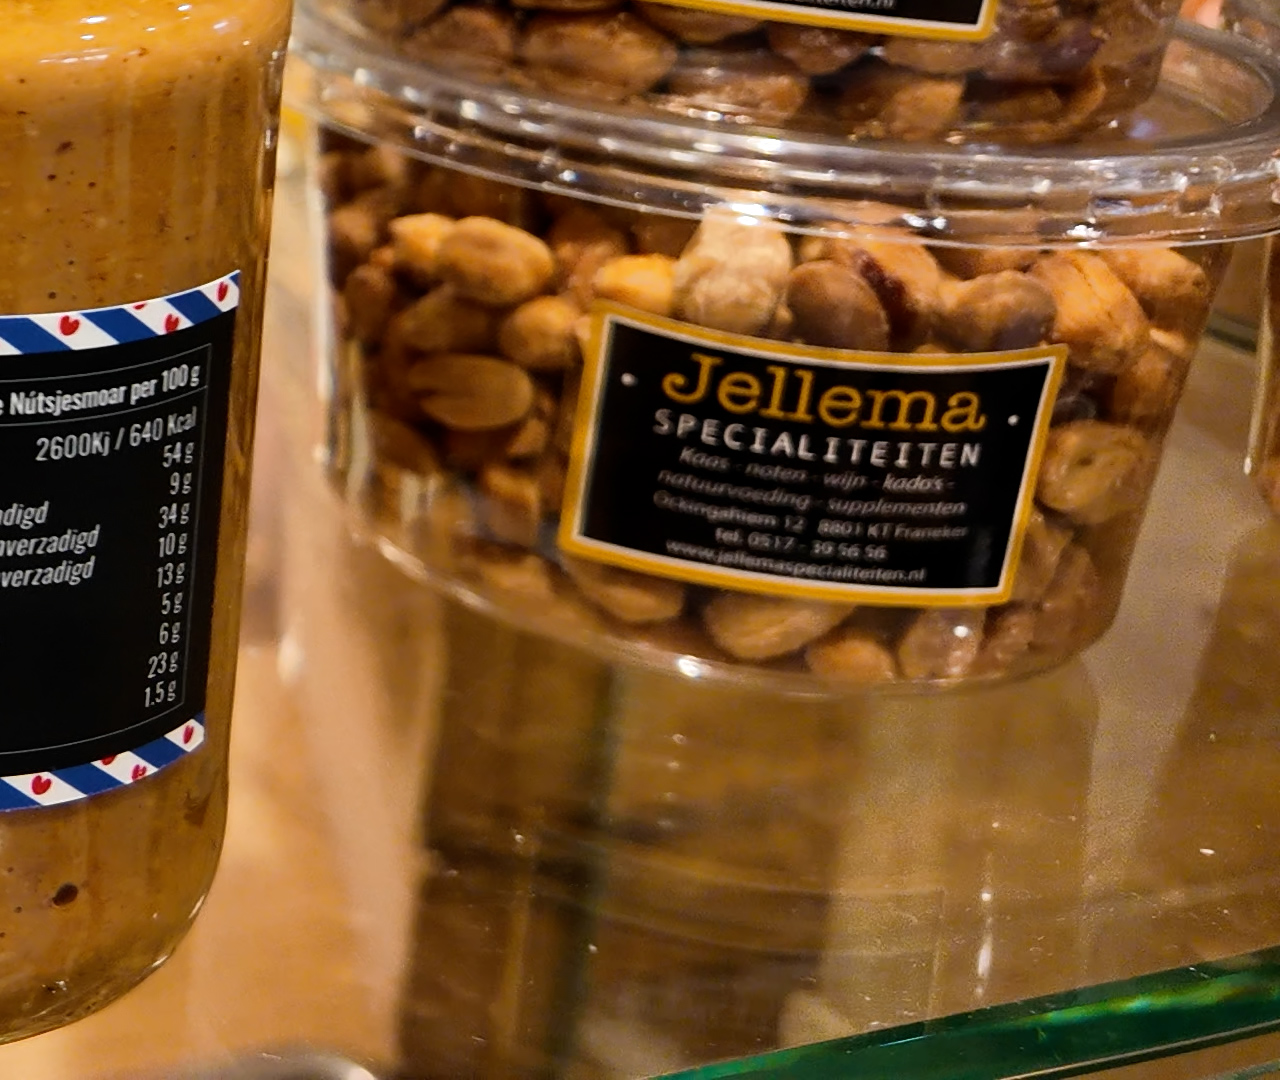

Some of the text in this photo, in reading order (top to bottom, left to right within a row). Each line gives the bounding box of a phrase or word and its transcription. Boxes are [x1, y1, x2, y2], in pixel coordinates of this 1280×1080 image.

[9, 386, 127, 416] Nútsjesmoar
[130, 379, 158, 405] per
[161, 364, 189, 392] 100
[190, 365, 200, 387] g
[661, 351, 987, 434] Jellema
[35, 431, 110, 461] 2600Kj
[114, 427, 125, 450] /
[129, 418, 163, 446] 640
[167, 406, 197, 436] Kcal
[652, 407, 982, 468] SPECIALITEITEN
[162, 442, 182, 467] 54
[184, 442, 194, 464] g
[170, 472, 180, 495] 9
[182, 472, 192, 494] g
[158, 502, 177, 528] 34
[180, 502, 190, 524] g
[159, 533, 176, 557] 10
[178, 533, 188, 554] g
[157, 562, 174, 588] 13
[175, 562, 186, 584] g
[161, 592, 171, 614] 5
[173, 592, 183, 614] g
[159, 622, 169, 644] 6
[171, 622, 181, 643] g
[148, 652, 167, 678] 23
[169, 651, 178, 673] g
[145, 681, 165, 707] 1.5
[167, 680, 176, 701] g
